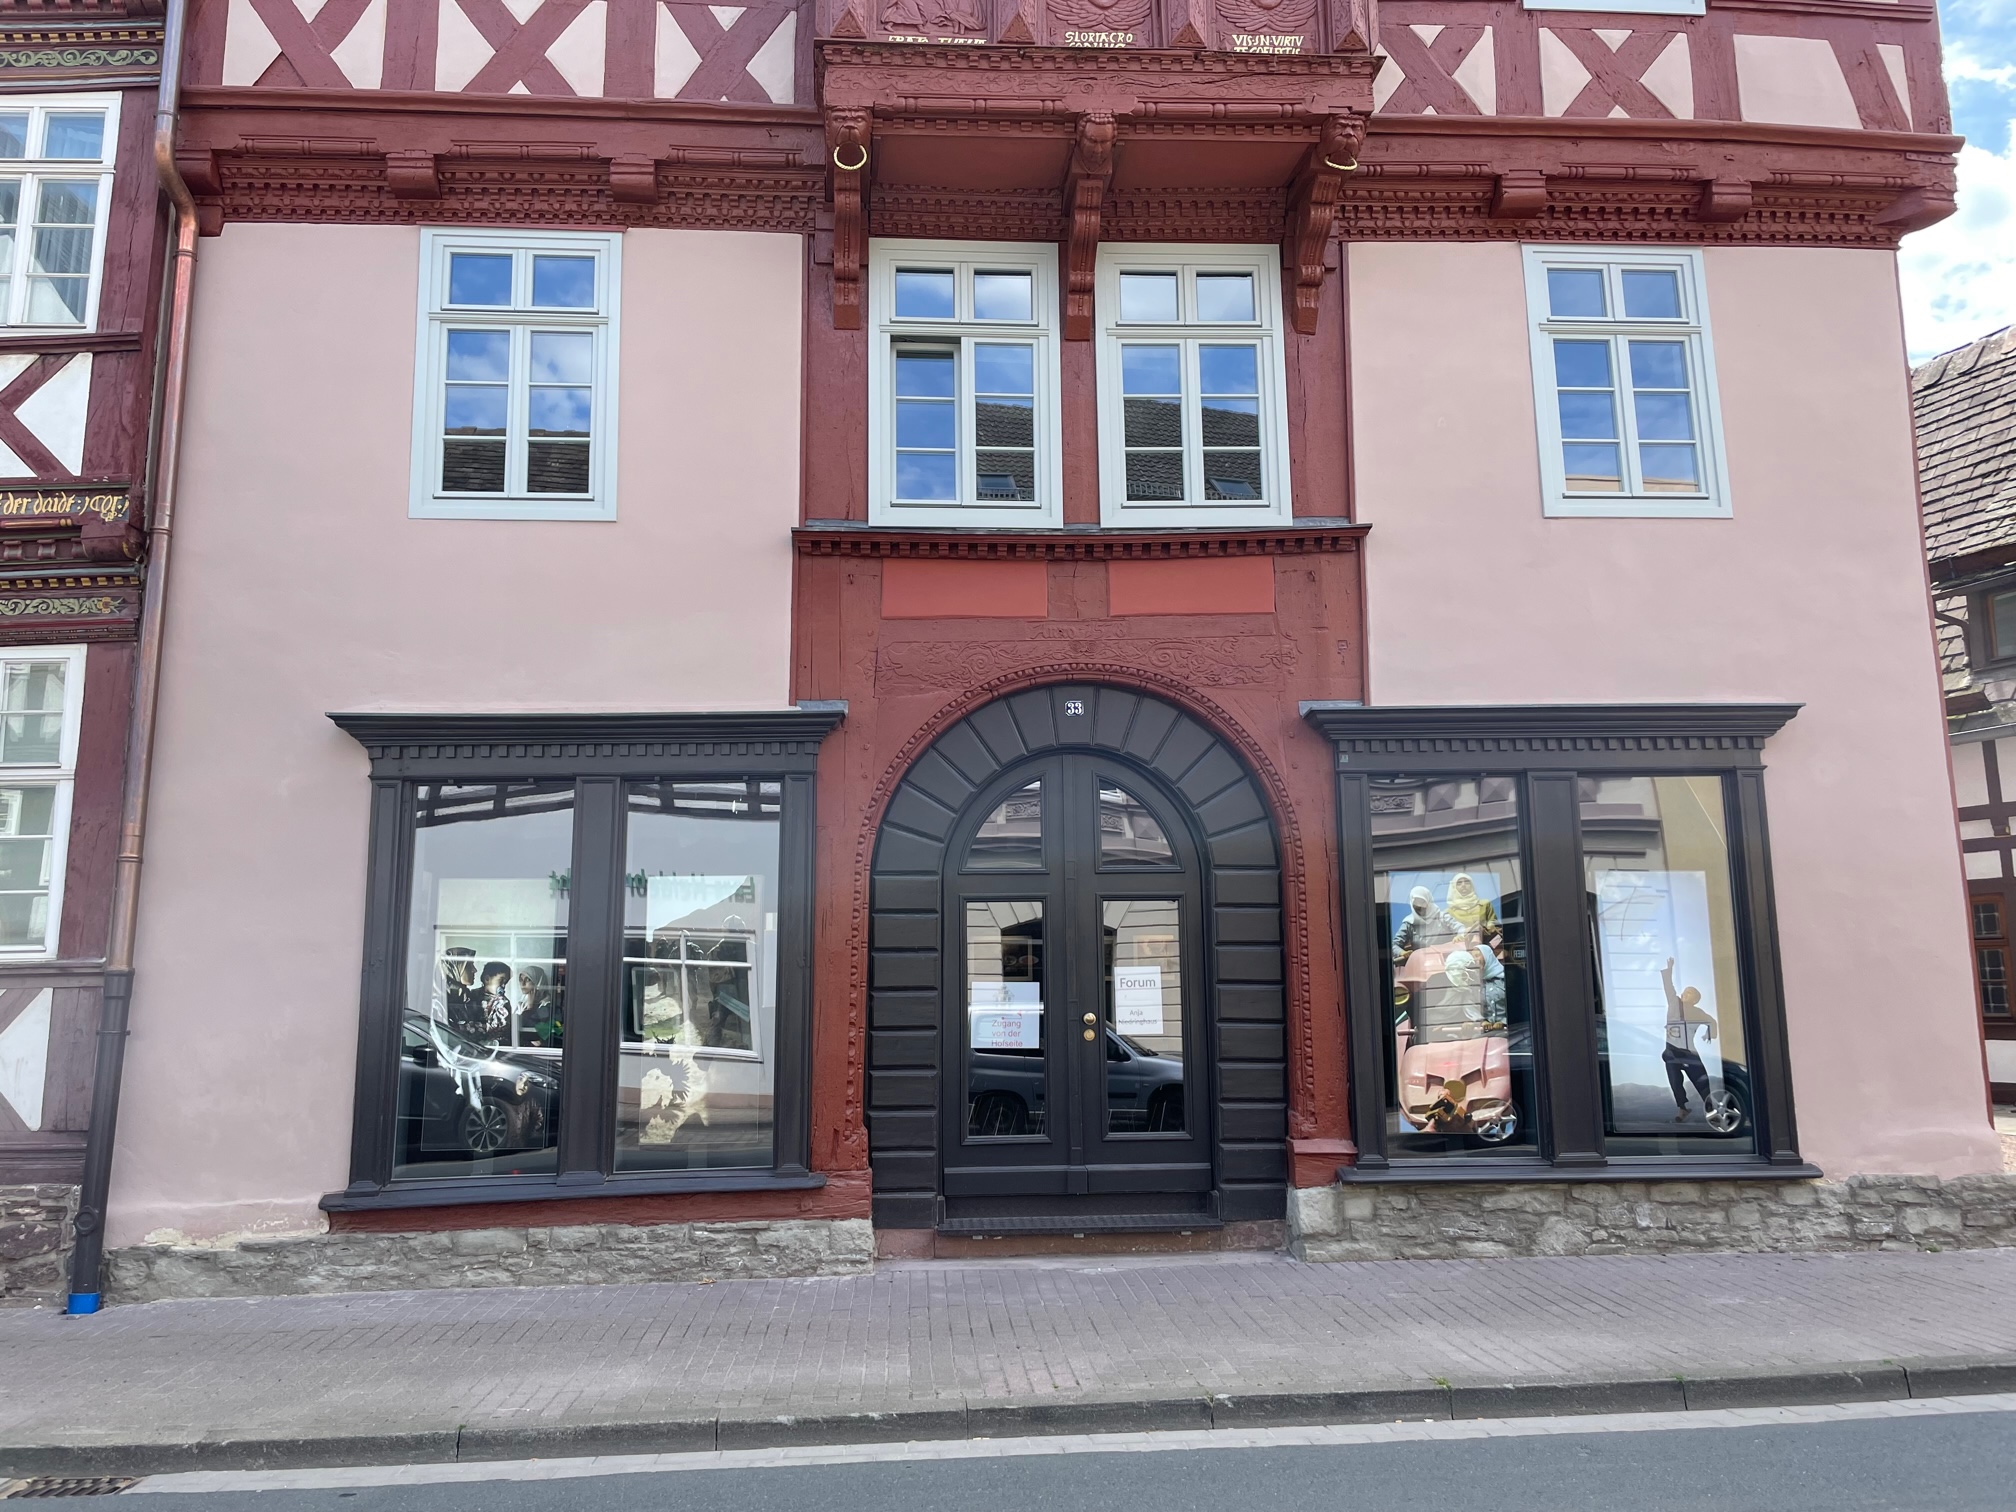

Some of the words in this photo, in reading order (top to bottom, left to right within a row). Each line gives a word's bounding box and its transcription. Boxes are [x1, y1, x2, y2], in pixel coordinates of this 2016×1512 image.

[1067, 702, 1082, 715] 33
[1120, 977, 1156, 988] Forum
[1129, 1009, 1143, 1017] Anja
[991, 1020, 1022, 1029] Zugang
[1007, 1029, 1021, 1038] der
[991, 1040, 1023, 1048] Hofseite
